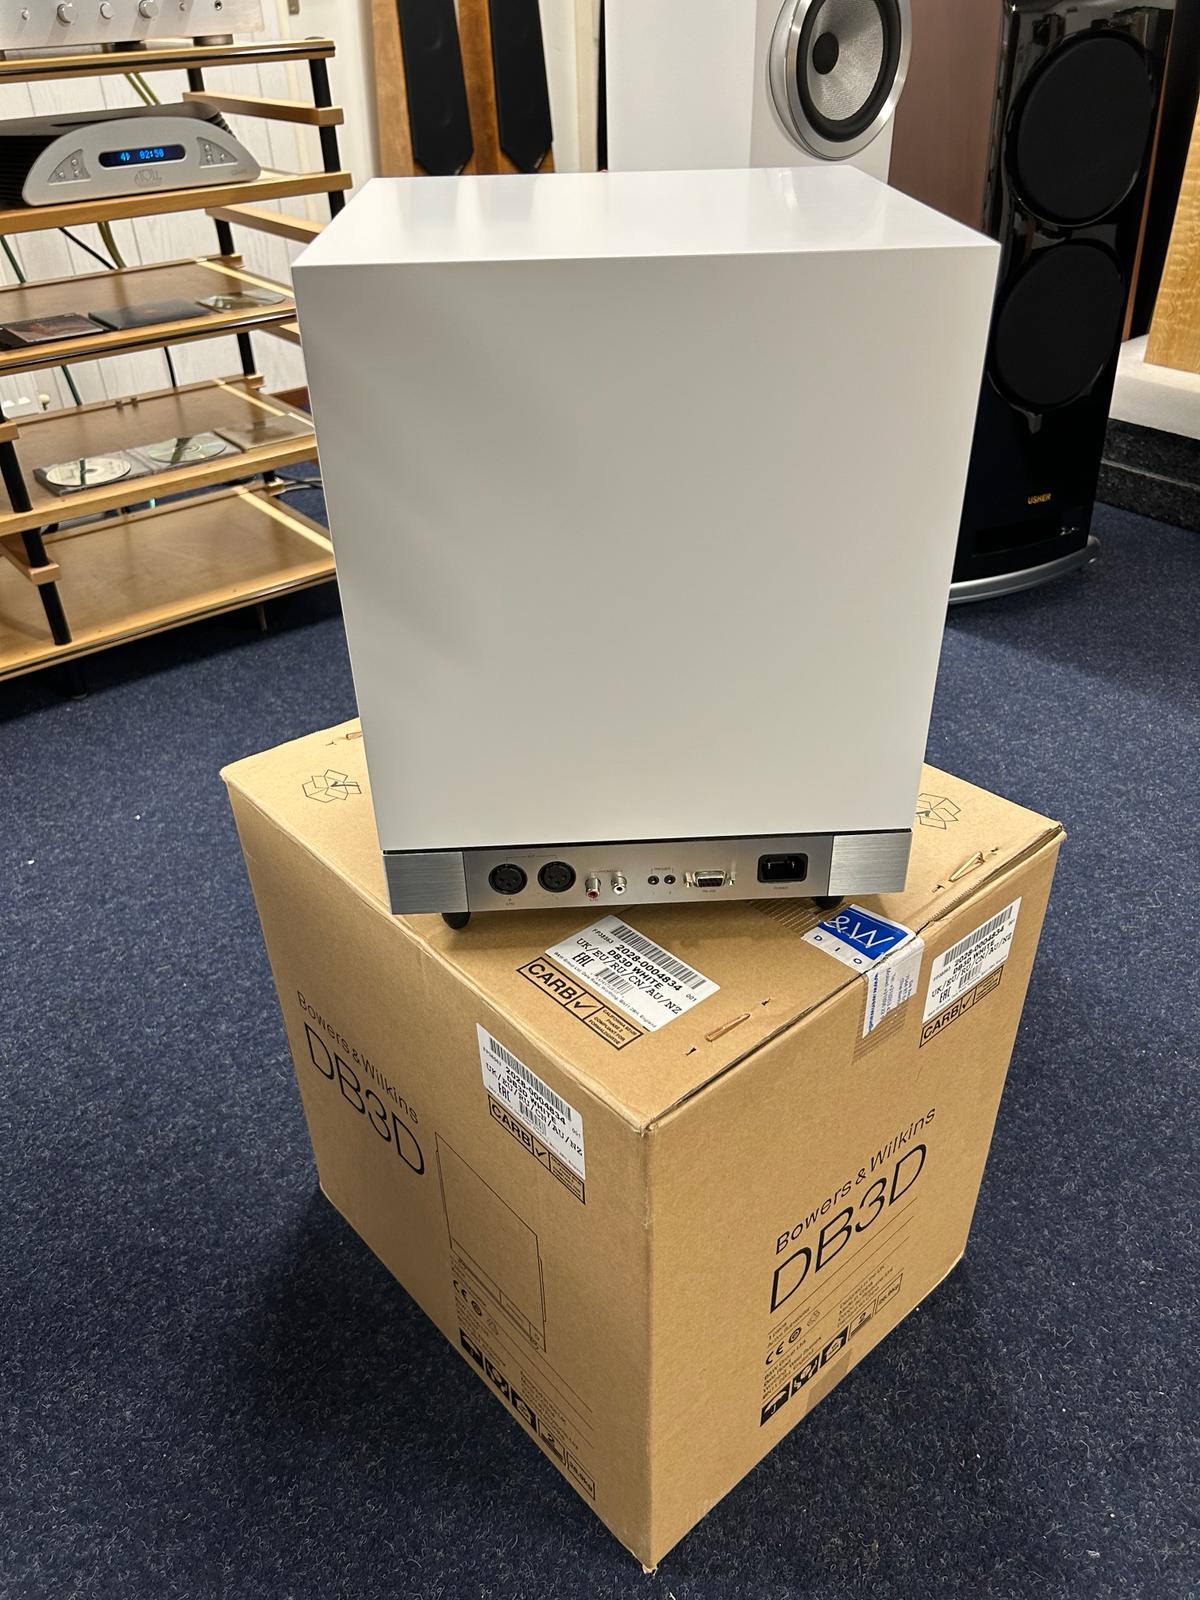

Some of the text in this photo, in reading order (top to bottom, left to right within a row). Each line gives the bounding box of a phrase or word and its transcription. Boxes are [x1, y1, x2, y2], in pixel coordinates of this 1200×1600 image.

[607, 949, 633, 968] DB3D
[632, 964, 664, 990] WHITE
[615, 944, 683, 991] 2028-0004834
[973, 940, 995, 959] WHITE
[528, 963, 578, 1000] CARB
[576, 937, 682, 1015] UK/EU/RU/CN/AU/NZ
[923, 1004, 959, 1040] CARB
[297, 990, 350, 1054] Bowers
[361, 1054, 418, 1124] Wilkins
[303, 1021, 425, 1175] DB3D
[530, 1095, 557, 1125] WHITE
[492, 1104, 531, 1147] CARB
[776, 1108, 936, 1255] Bowers & Wilkins
[769, 1144, 927, 1314] DB3D
